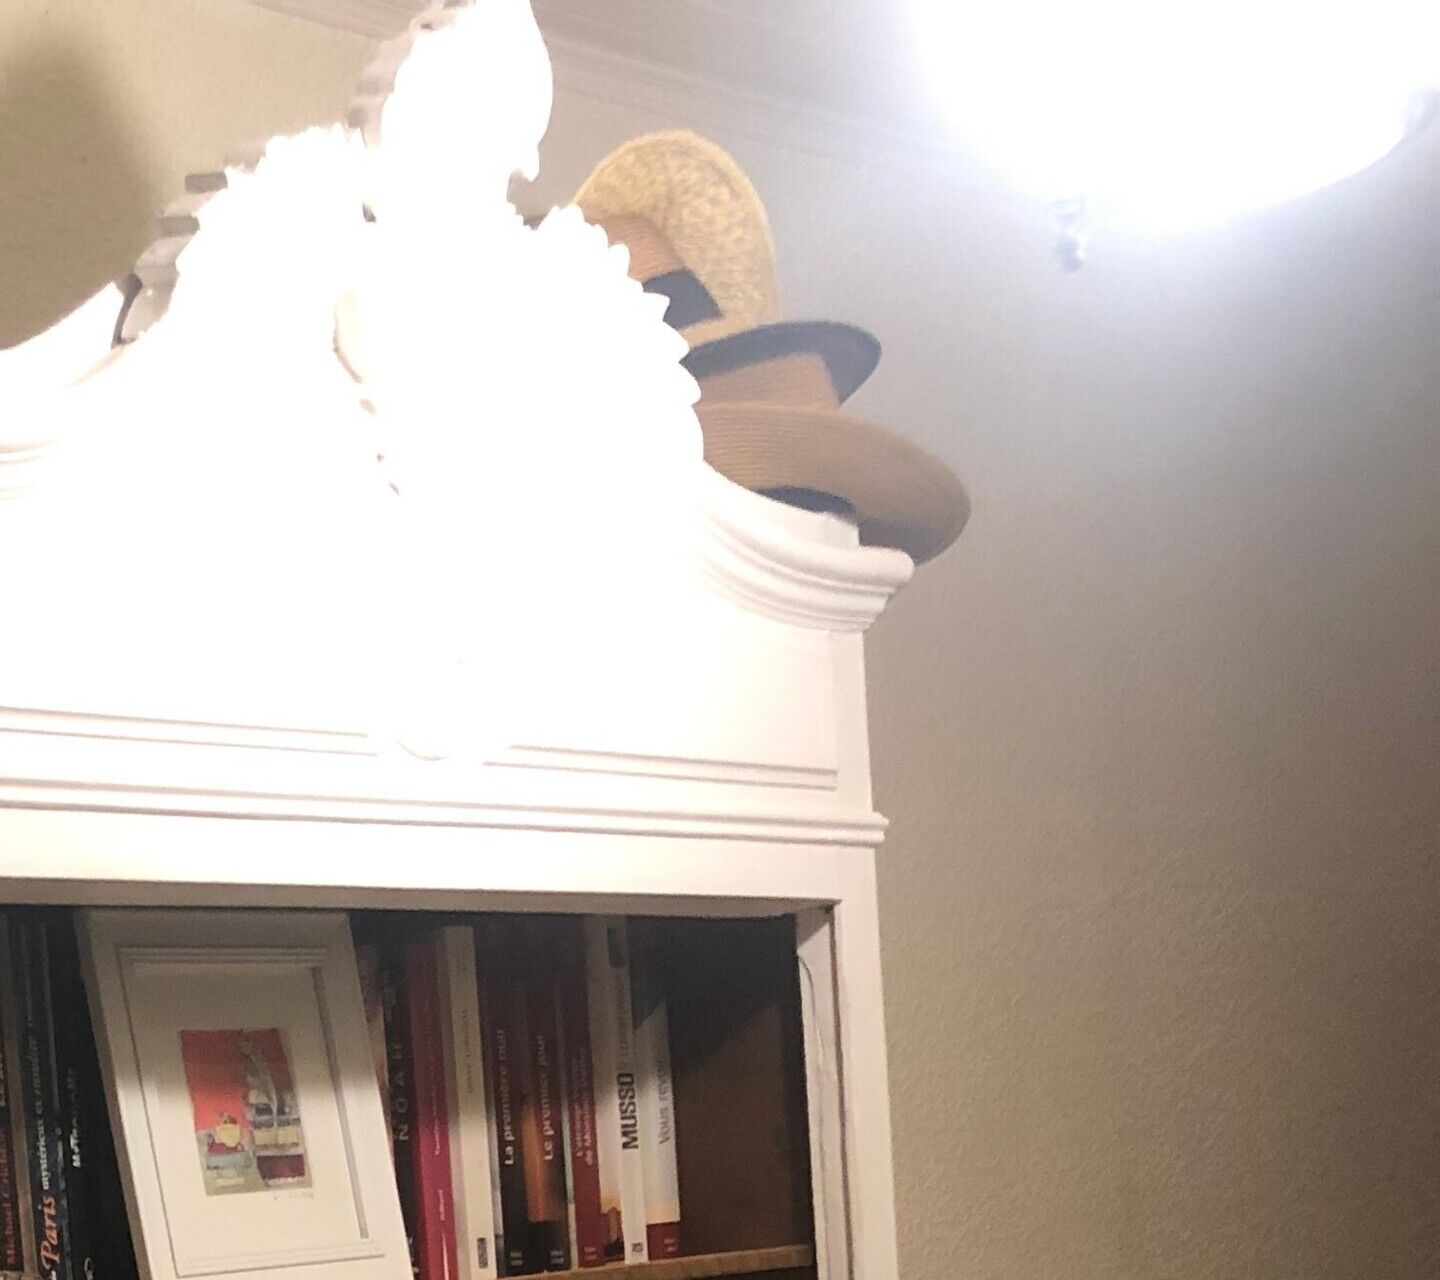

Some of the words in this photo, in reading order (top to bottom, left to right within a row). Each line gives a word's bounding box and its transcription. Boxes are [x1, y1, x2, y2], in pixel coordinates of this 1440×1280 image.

[393, 1045, 409, 1141] NOAH
[617, 1072, 640, 1151] MUSSO
[504, 1146, 515, 1166] La
[543, 1141, 554, 1161] Le
[38, 1195, 60, 1271] Paris
